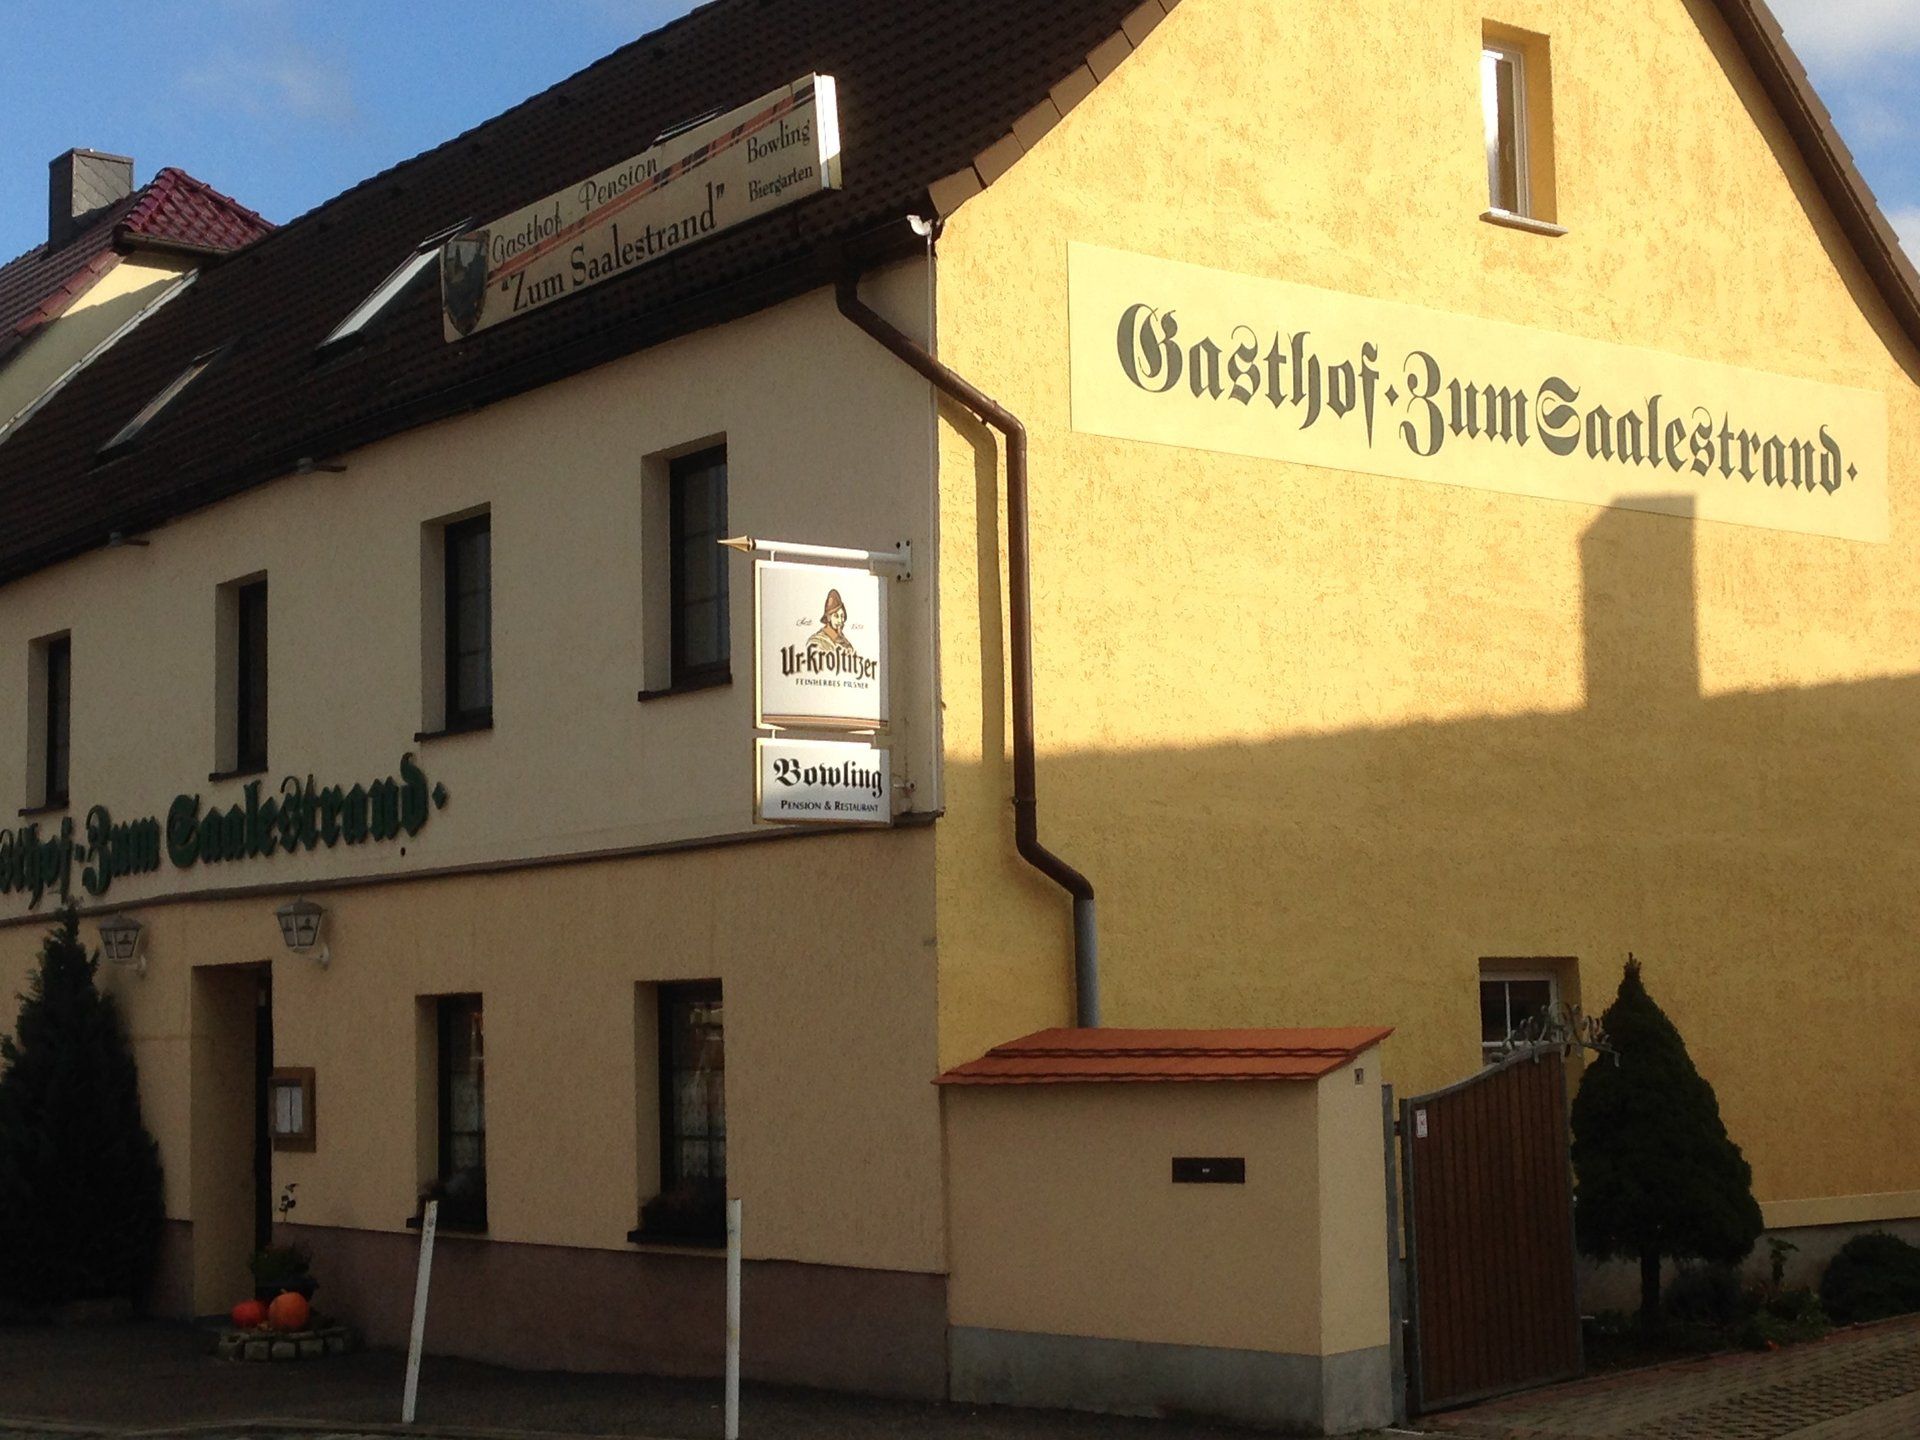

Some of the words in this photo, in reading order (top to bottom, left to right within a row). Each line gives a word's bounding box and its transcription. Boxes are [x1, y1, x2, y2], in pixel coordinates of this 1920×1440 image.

[747, 119, 811, 164] Bowling
[748, 165, 813, 202] Biergarten
[492, 201, 562, 265] Gasthof
[578, 158, 658, 211] Pension
[773, 757, 883, 799] Bowling
[824, 800, 833, 811] &
